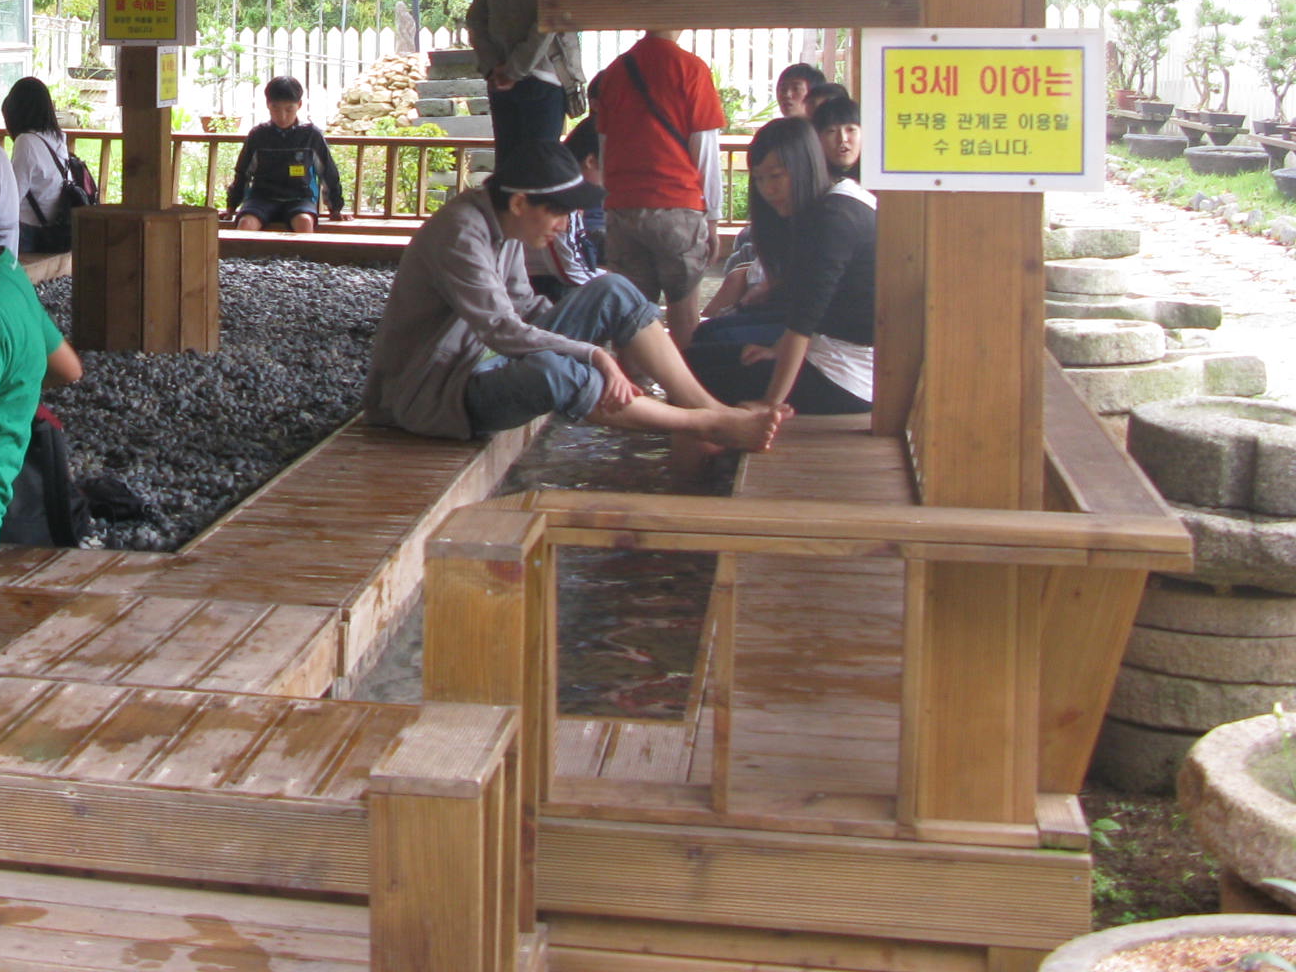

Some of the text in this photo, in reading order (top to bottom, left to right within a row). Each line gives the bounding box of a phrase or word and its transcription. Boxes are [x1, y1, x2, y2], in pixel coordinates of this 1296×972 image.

[894, 66, 1073, 97] 13세 이하는
[897, 113, 1070, 131] 부작용 관계로 이용할
[933, 139, 1033, 156] 수 없습니다.
